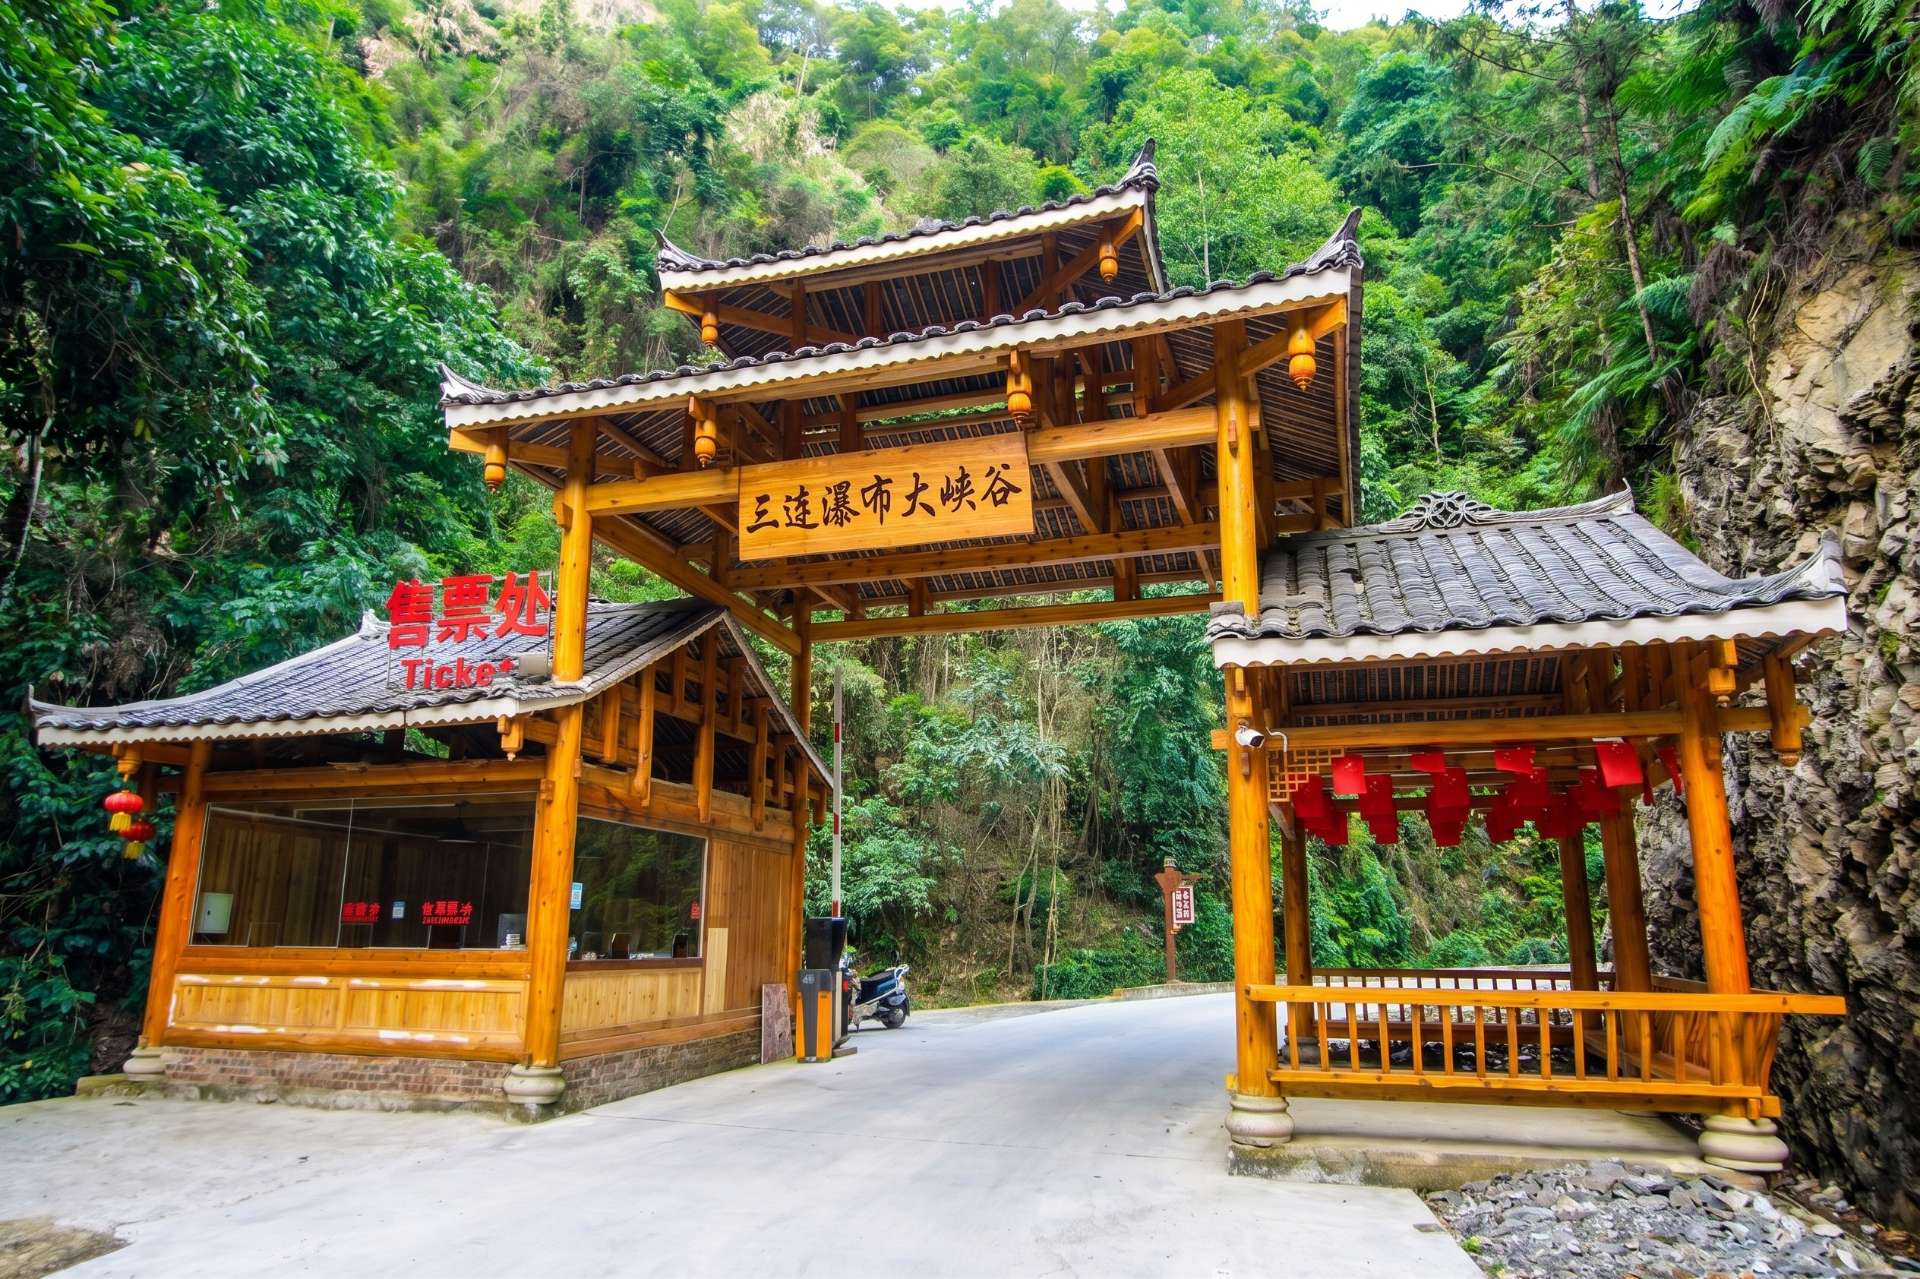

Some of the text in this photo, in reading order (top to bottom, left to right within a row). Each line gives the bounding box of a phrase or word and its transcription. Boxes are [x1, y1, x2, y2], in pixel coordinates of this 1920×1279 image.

[747, 463, 1022, 533] 三连瀑布大峡谷
[386, 570, 550, 649] 售票处
